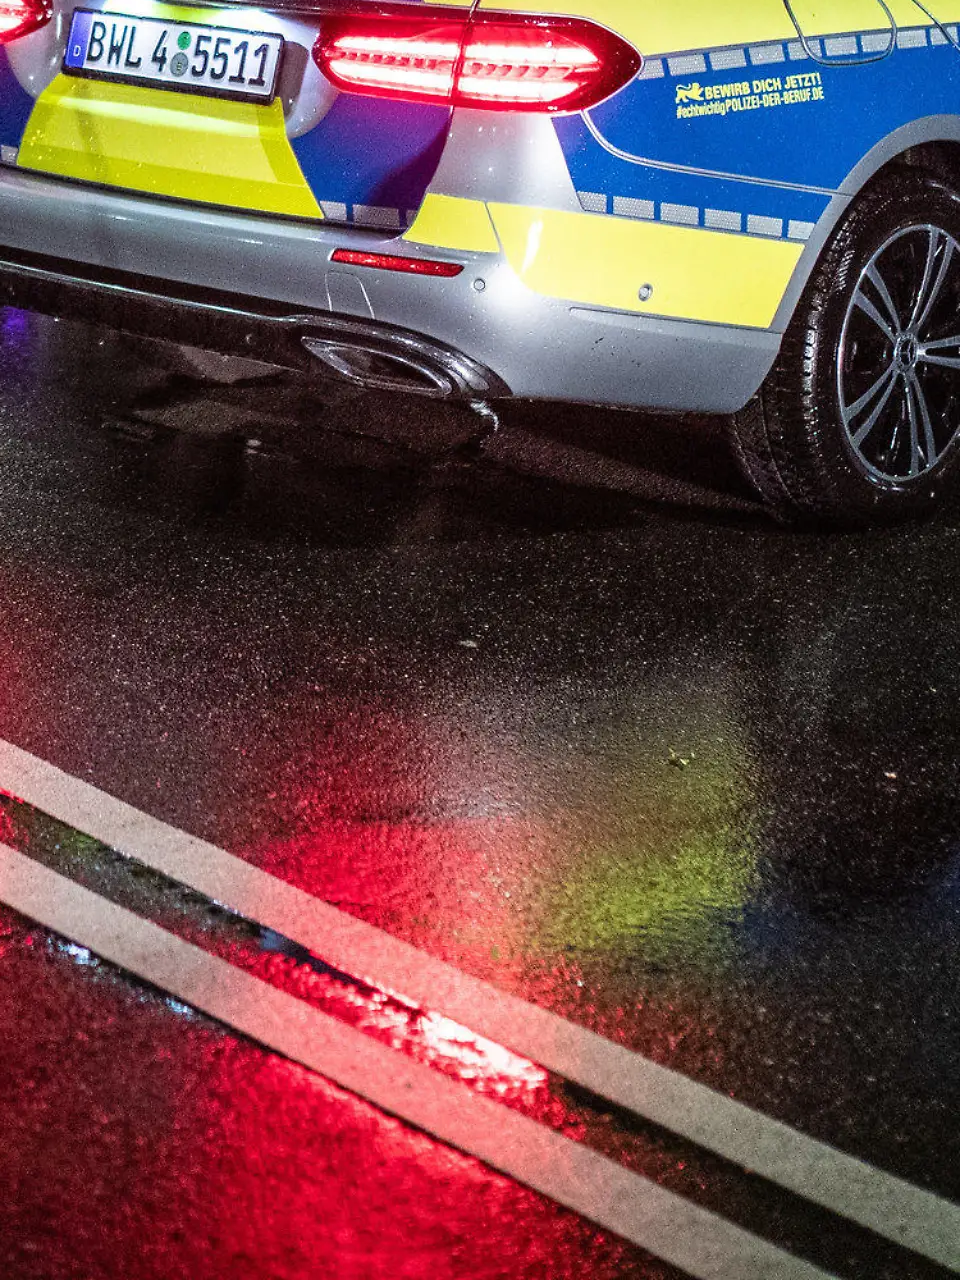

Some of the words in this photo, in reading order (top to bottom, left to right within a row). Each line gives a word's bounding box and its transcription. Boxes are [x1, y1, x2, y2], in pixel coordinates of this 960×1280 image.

[73, 44, 81, 58] D
[86, 21, 142, 69] BWL
[151, 29, 168, 73] 4
[191, 35, 270, 87] 5511
[704, 81, 750, 100] BEWIRB
[752, 77, 782, 94] DICH
[784, 72, 822, 90] JETZT!
